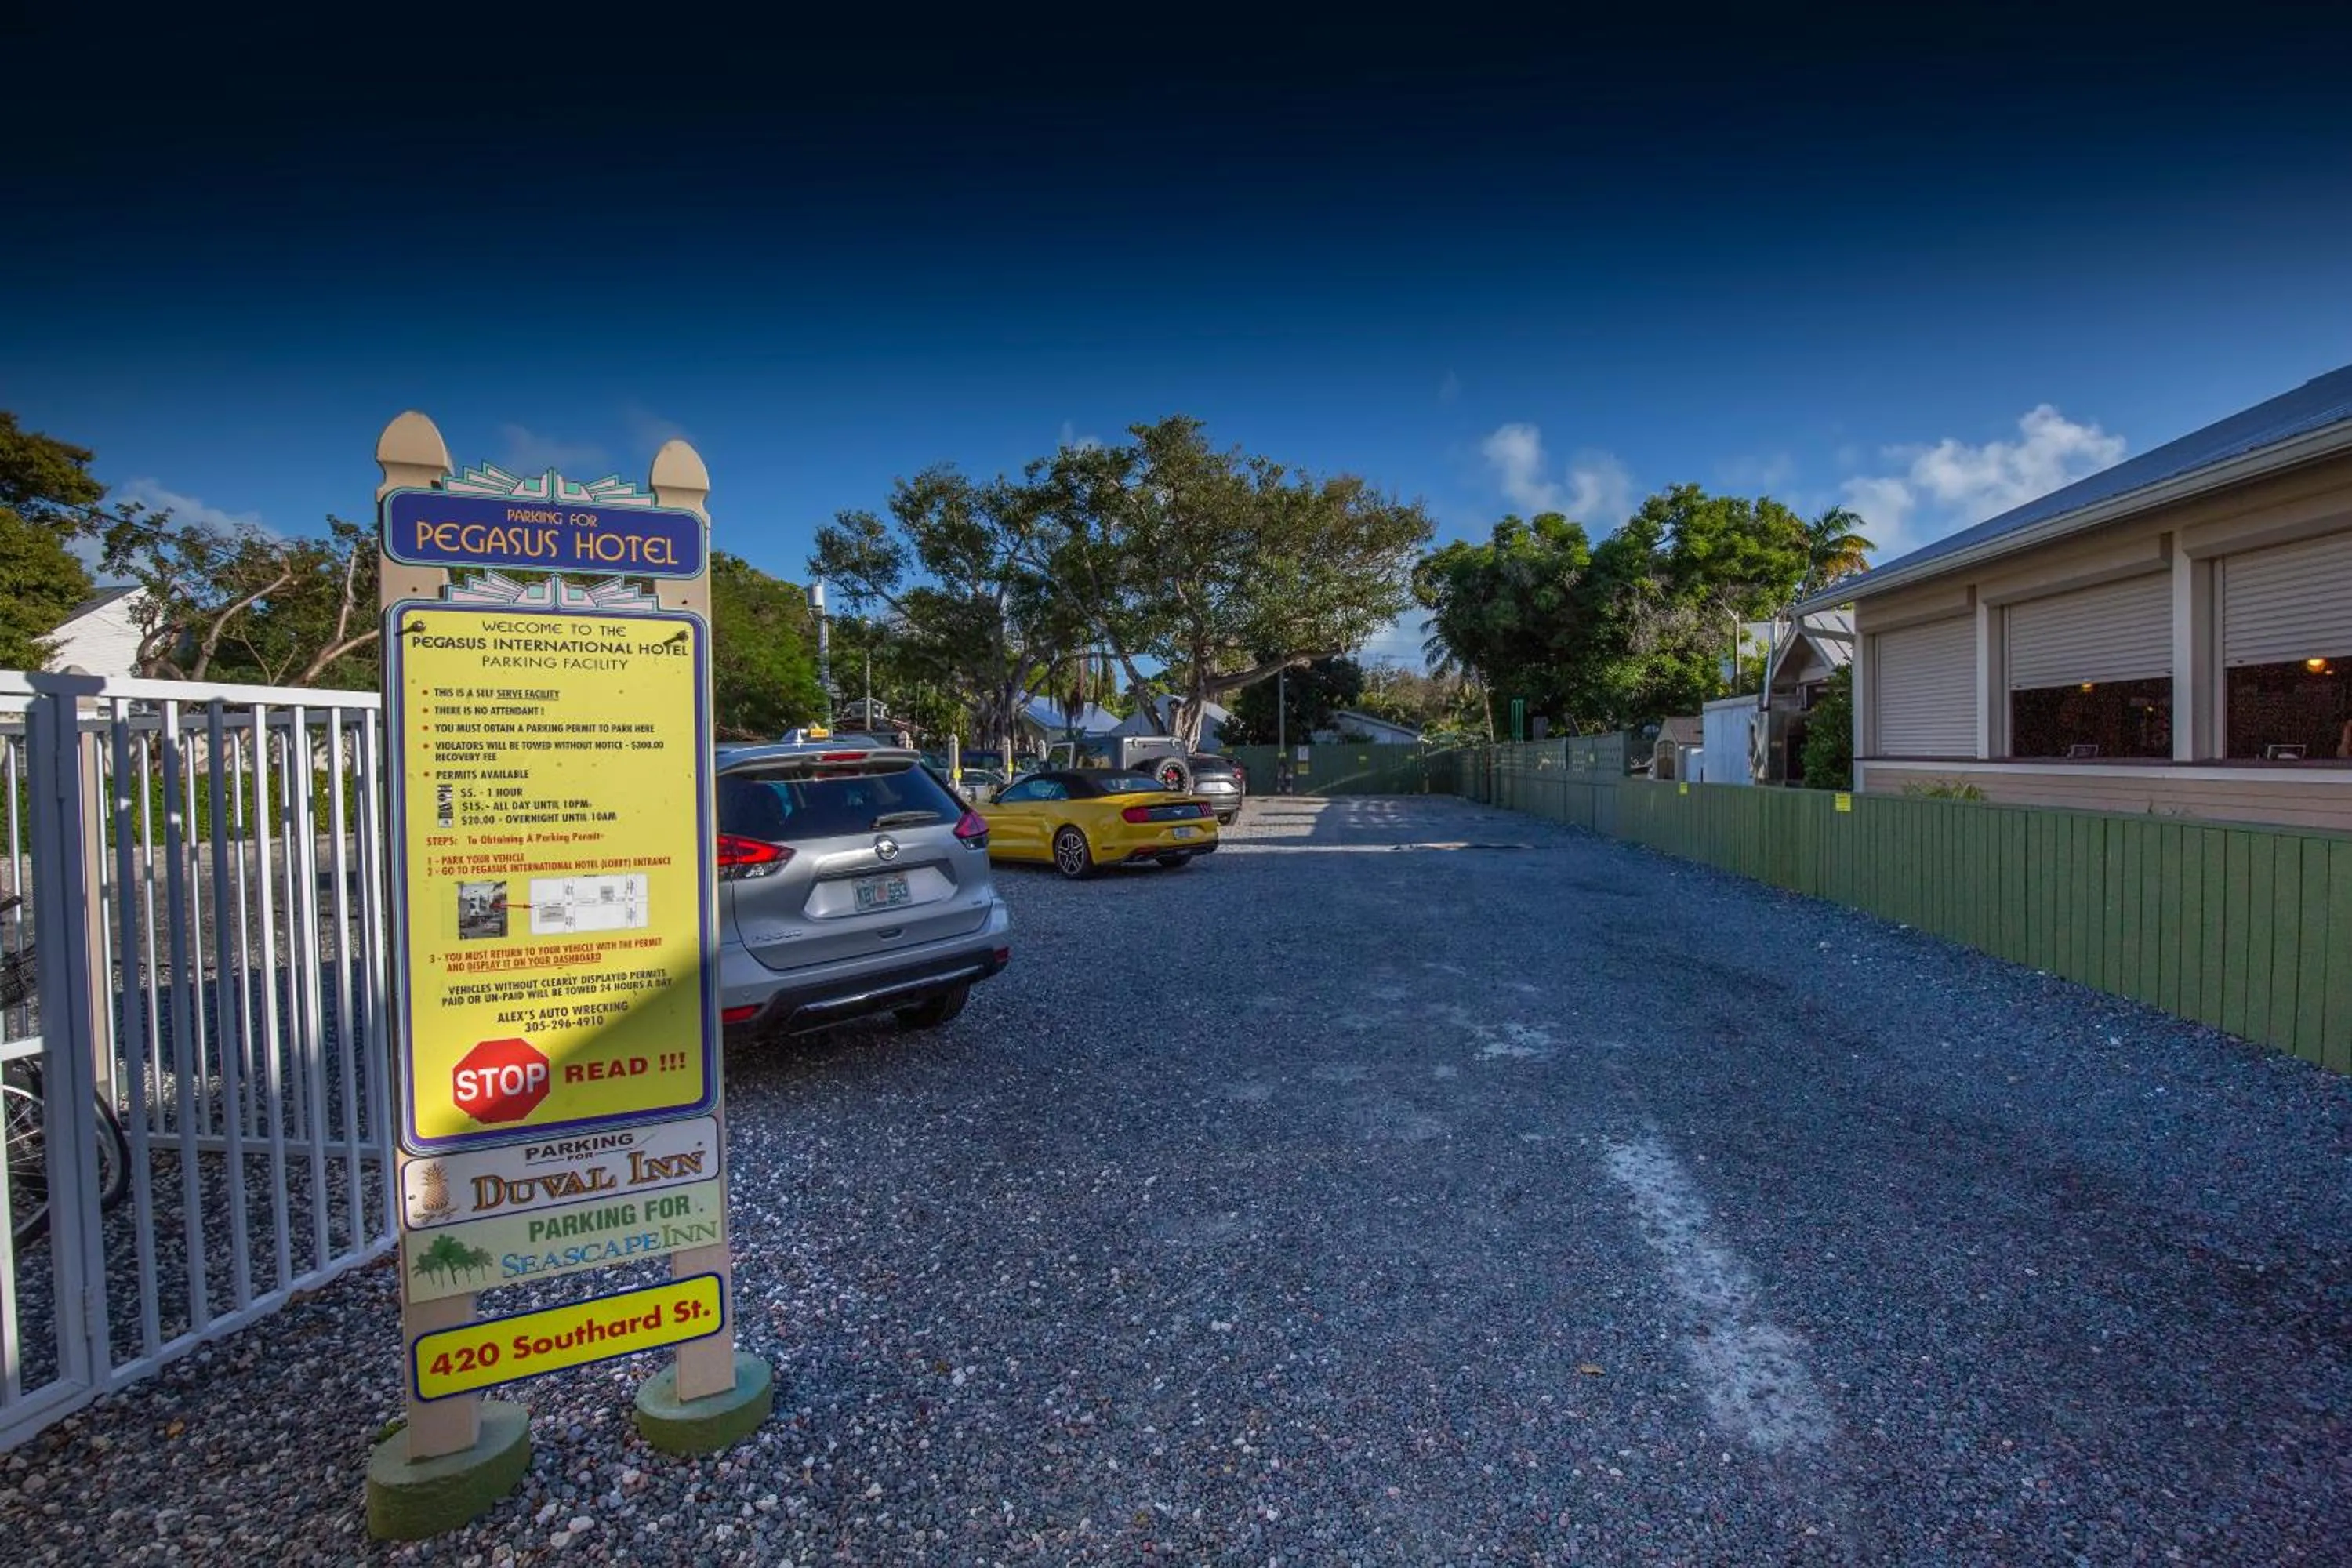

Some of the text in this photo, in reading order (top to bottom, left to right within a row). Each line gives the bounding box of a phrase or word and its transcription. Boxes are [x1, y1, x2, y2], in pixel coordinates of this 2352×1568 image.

[507, 508, 598, 528] PARKING FOR
[416, 521, 679, 565] PEGASUS HOTEL
[482, 620, 626, 637] WELCOME TO THE
[412, 636, 689, 657] PEGASUS INTERNATIONAL HOTEL
[482, 655, 629, 671] PARKING FACILITY
[434, 688, 560, 700] THIS IS A SELF SERVE FACILITY
[434, 706, 461, 715] THERE
[463, 706, 471, 715] IS
[474, 706, 488, 715] NO
[490, 706, 539, 716] ATTENDANT
[435, 724, 454, 732] YOU
[456, 724, 481, 732] MUST
[484, 724, 515, 733] OBTAIN
[526, 724, 564, 732] PARKING
[566, 724, 596, 733] PERMIT
[435, 741, 484, 750] VIOLATORS
[486, 741, 507, 750] WILL
[521, 741, 552, 750] TOWED
[554, 741, 593, 750] WITHOUT
[595, 741, 623, 750] NOTICE
[435, 753, 496, 761] RECOVERY FEE
[436, 770, 529, 780] PERMITS AVAILABLE
[488, 788, 492, 797] 1
[496, 788, 523, 797] HOUR
[493, 801, 509, 810] ALL
[512, 801, 531, 810] DAY
[533, 800, 559, 810] UNTIL
[461, 815, 495, 826] $20.00
[505, 814, 559, 823] OVERNIGHT
[562, 813, 587, 822] UNTIL
[592, 812, 617, 822] 10AM
[426, 837, 458, 846] STEPS:
[466, 835, 477, 845] To
[481, 834, 524, 846] Obtaining
[526, 834, 533, 843] A
[536, 833, 570, 844] Parking
[441, 855, 463, 865] PARK
[466, 854, 490, 863] YOUR
[493, 853, 525, 862] VEHICLE
[441, 866, 454, 876] GO
[457, 866, 468, 875] TO
[471, 864, 507, 874] PEGASUS
[510, 861, 572, 873] INTERNATIONAL
[575, 859, 599, 869] HOTEL
[633, 857, 671, 866] ENTRANCE
[430, 955, 435, 964] 3
[445, 953, 463, 962] YOU
[465, 950, 488, 960] MUST
[490, 949, 523, 958] RETURN
[525, 947, 535, 956] TO
[539, 946, 561, 955] YOUR
[563, 943, 593, 953] VEHICLE
[596, 942, 617, 951] WITH
[619, 941, 633, 949] THE
[634, 938, 662, 948] PERMIT
[447, 953, 601, 972] AND DISPLAY IT ON YOUR DASHBOARD
[448, 968, 666, 995] VEHICLES WITHOUT CLEARLY DISPLAYED PERMITS
[441, 978, 672, 1007] PAID OR UN-PAID WILL BE TOWED 24 HOURS A DAY
[497, 1001, 628, 1023] ALEX'S AUTO WRECKING
[524, 1015, 604, 1033] 305-296-4910
[456, 1062, 546, 1102] STOP
[565, 1057, 648, 1083] READ
[524, 1133, 634, 1160] PARKING
[567, 1151, 593, 1163] FOR
[472, 1149, 706, 1213] DUVAL INN
[528, 1194, 690, 1243] PARKING FOR
[430, 1299, 711, 1377] 420 Southard St.
